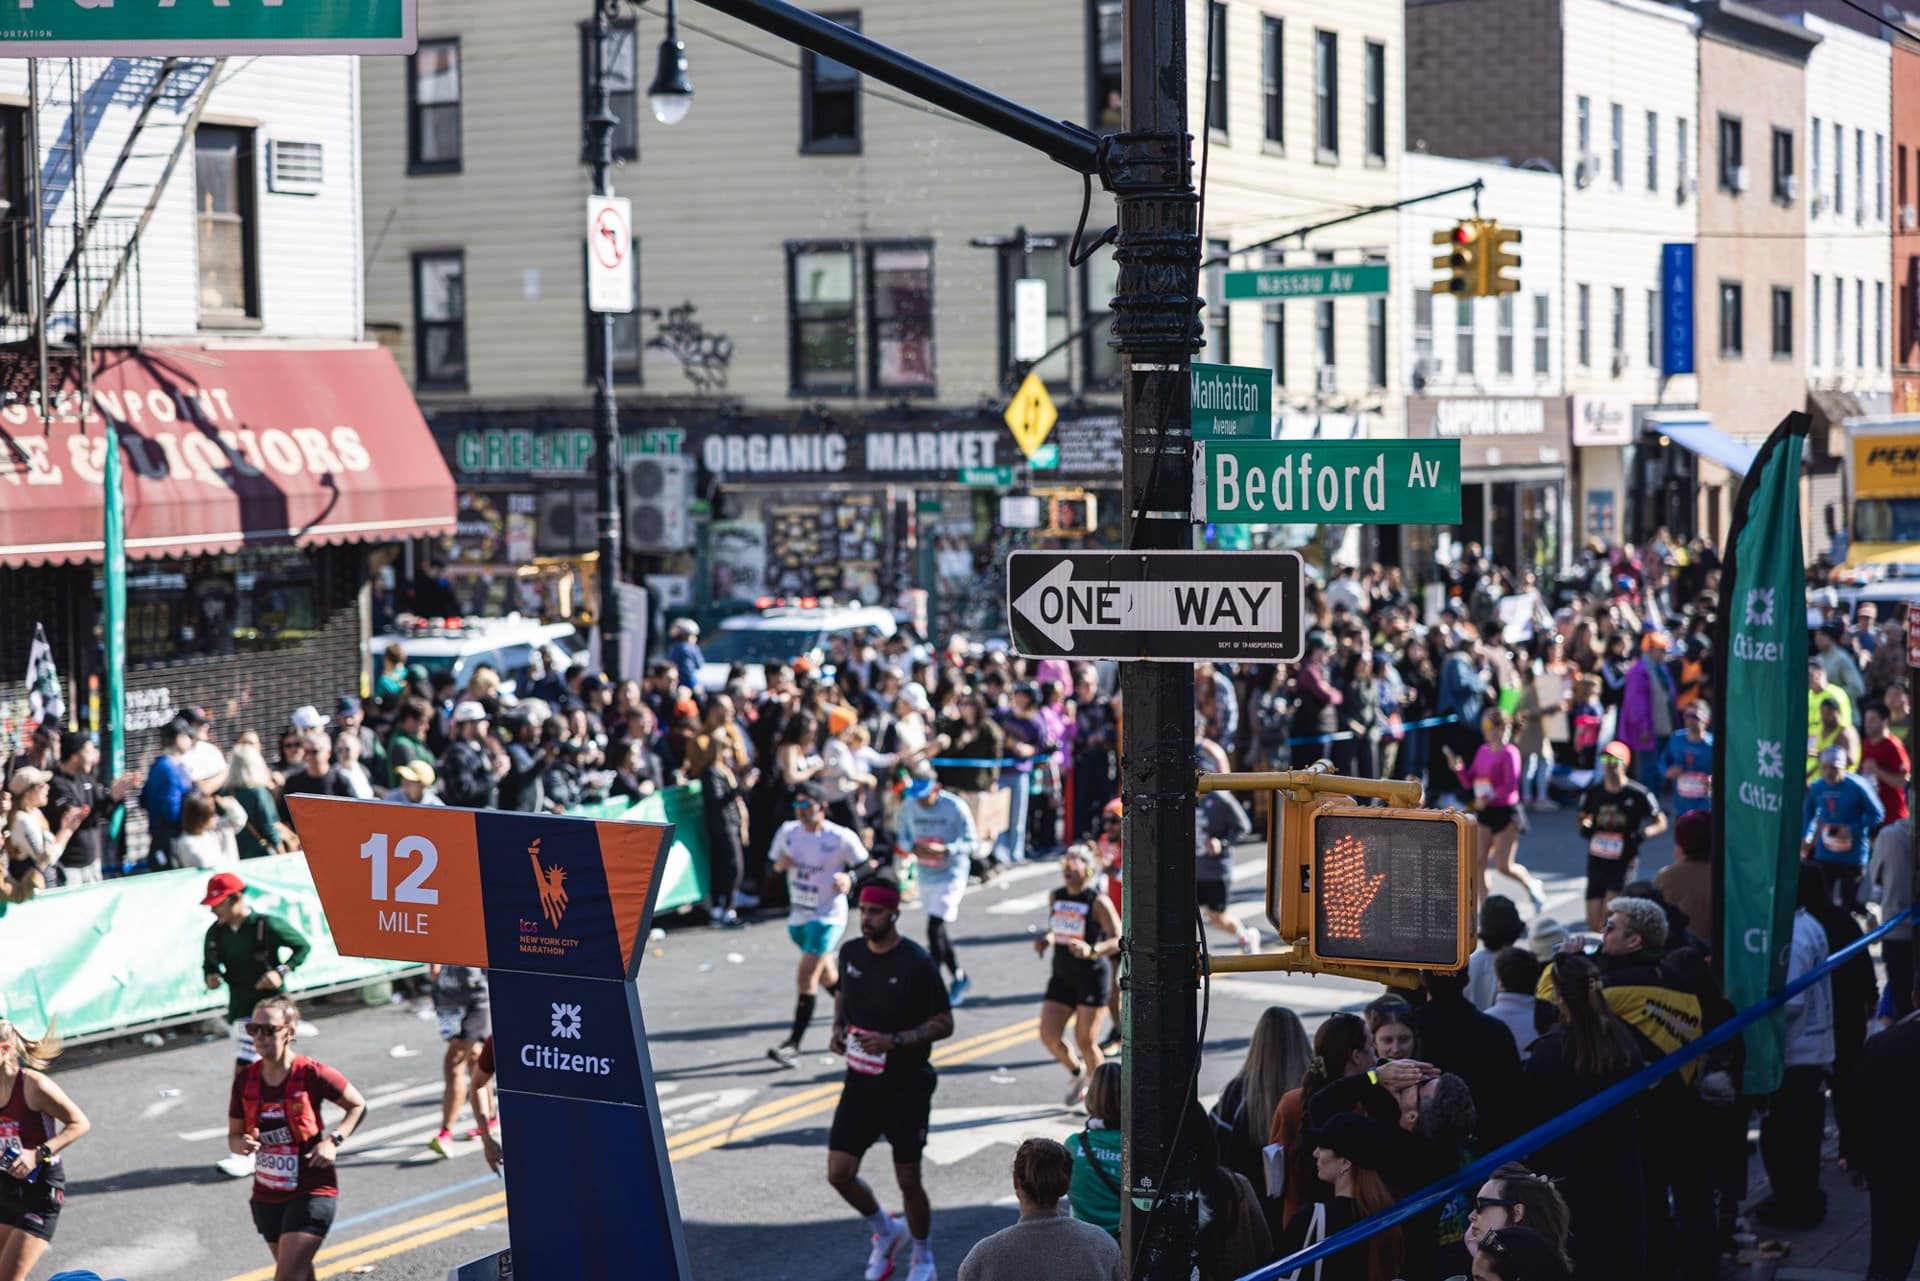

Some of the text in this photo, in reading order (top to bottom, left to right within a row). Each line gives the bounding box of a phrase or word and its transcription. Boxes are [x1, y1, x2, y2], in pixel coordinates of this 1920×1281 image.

[1257, 271, 1354, 294] Nassau Av
[1671, 249, 1687, 370] TACOS
[1191, 371, 1258, 412] Manhattan
[1213, 416, 1237, 435] Avenue
[122, 426, 371, 488] LIQUORS
[457, 427, 686, 474] GREENPINT
[703, 433, 847, 473] ORGANIC
[866, 431, 998, 471] MARKET
[1216, 452, 1440, 511] Bedford Av
[1040, 586, 1272, 626] ONE WAY
[1242, 641, 1283, 649] TRANSPORTATION
[360, 832, 439, 905] 12
[378, 910, 429, 935] MILE
[520, 935, 579, 947] NEW YORK CITY
[520, 945, 565, 956] MARATHON
[520, 1044, 611, 1076] Citizens
